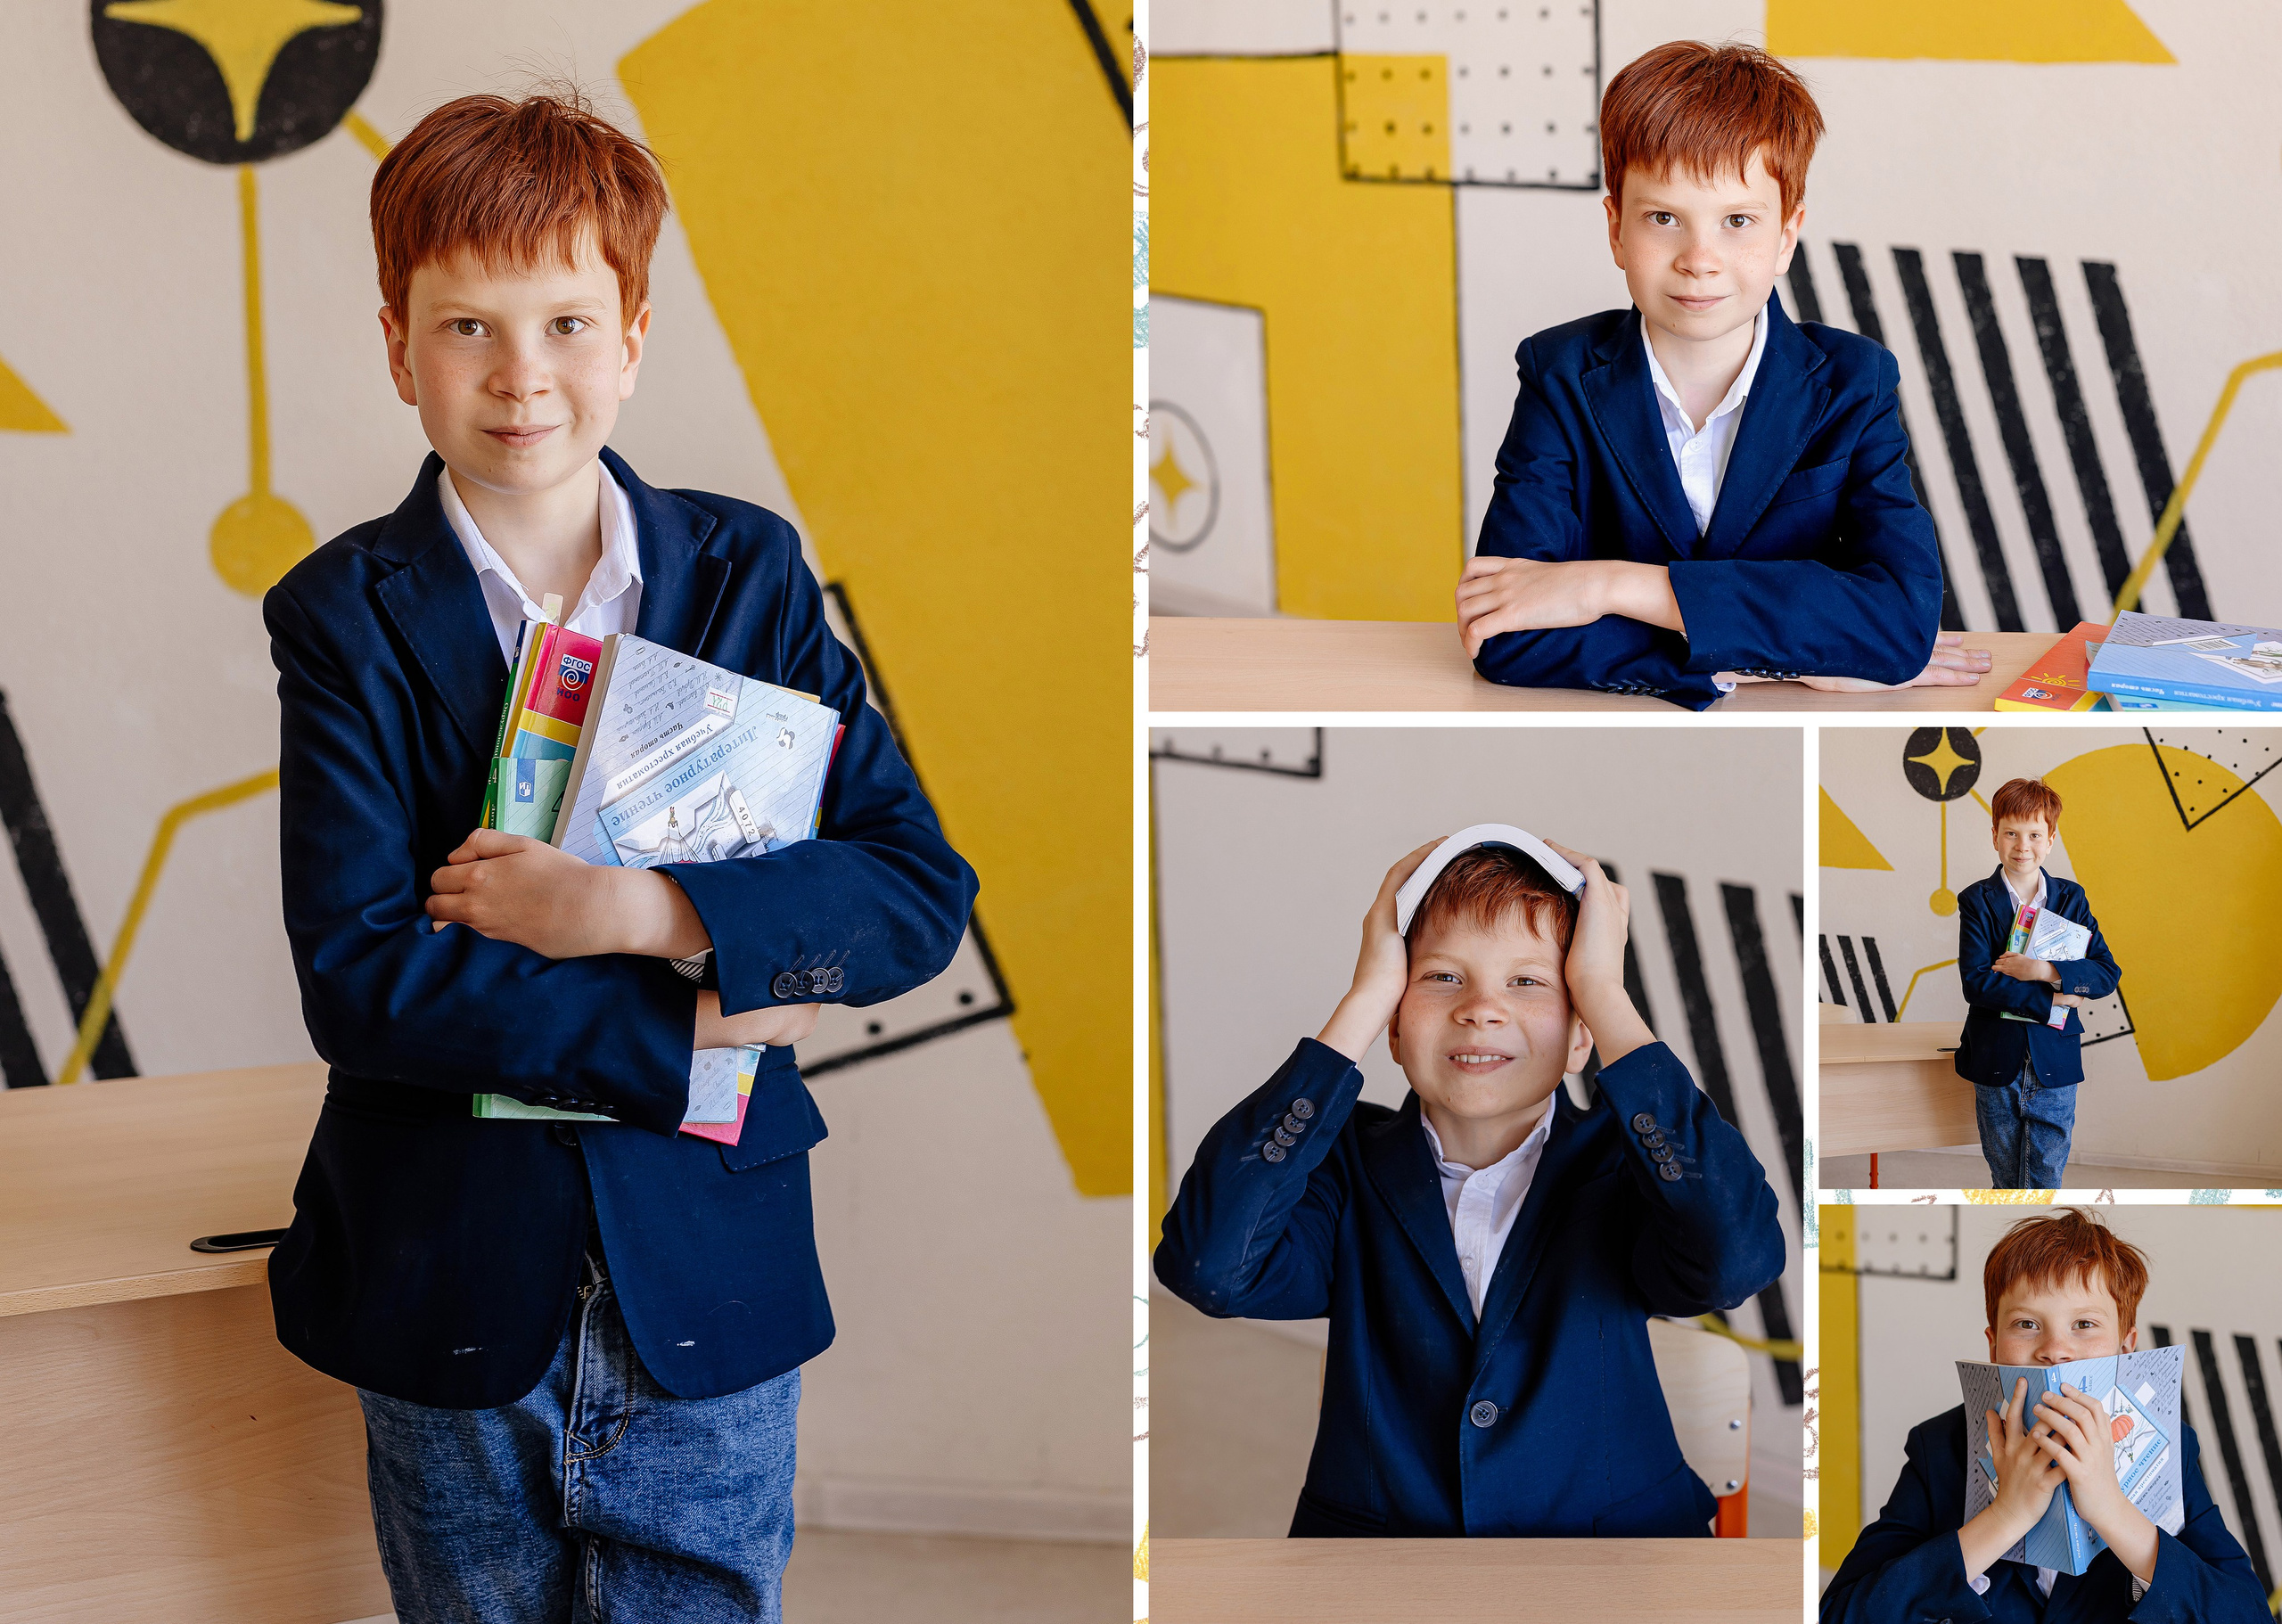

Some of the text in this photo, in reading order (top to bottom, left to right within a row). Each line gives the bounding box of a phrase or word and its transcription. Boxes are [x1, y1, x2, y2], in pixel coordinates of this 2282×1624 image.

[562, 655, 591, 672] ФГОС
[615, 722, 713, 790] Учебная хрестоматия
[628, 720, 684, 760] Часть вторая
[662, 726, 758, 794] Литературное
[609, 788, 662, 828] чтение
[737, 805, 756, 836] 4072
[2050, 1372, 2056, 1382] 4
[2077, 1375, 2087, 1392] 4
[2118, 1466, 2139, 1492] урное
[2138, 1438, 2163, 1468] чтение
[2128, 1489, 2138, 1502] ная
[2137, 1456, 2164, 1490] хрестоматия
[2135, 1490, 2148, 1505] Часть
[2147, 1474, 2162, 1491] вторая
